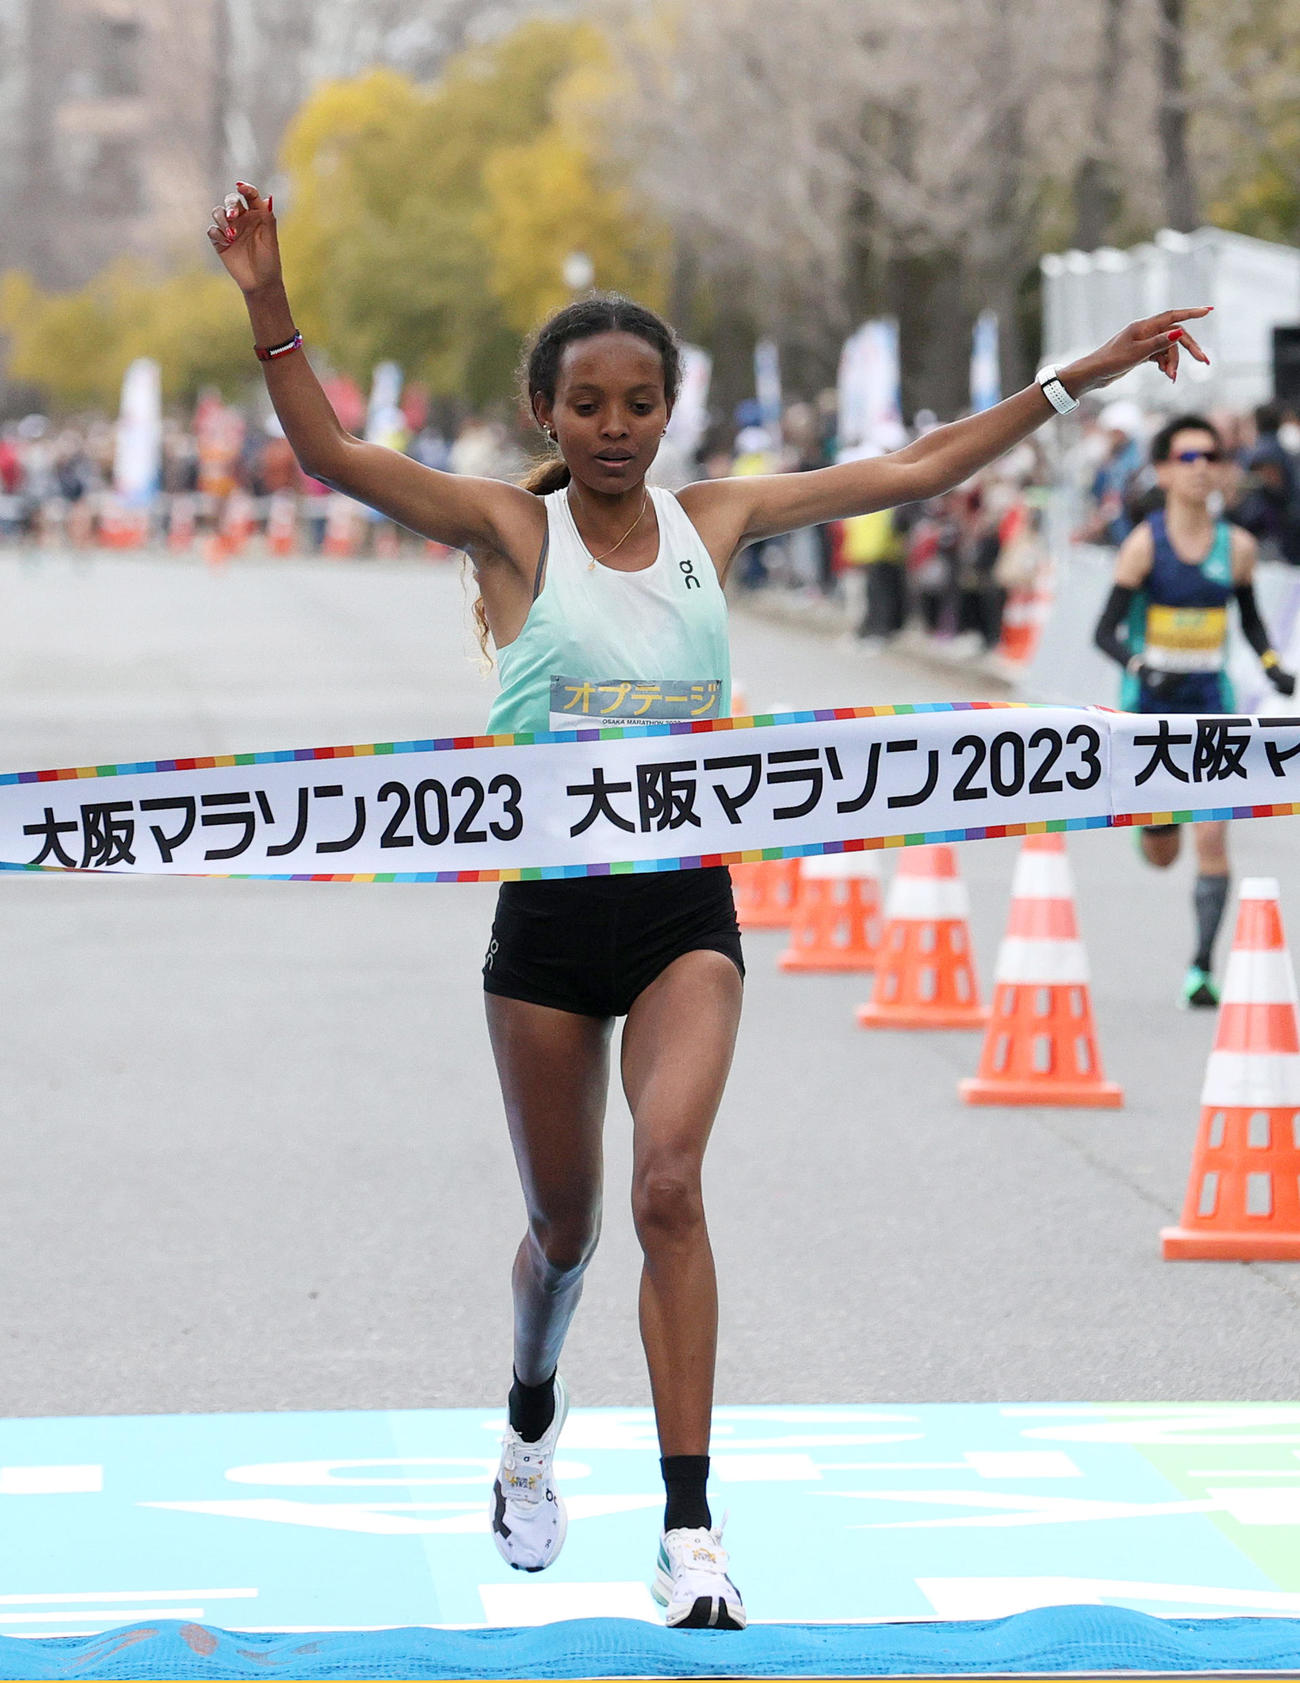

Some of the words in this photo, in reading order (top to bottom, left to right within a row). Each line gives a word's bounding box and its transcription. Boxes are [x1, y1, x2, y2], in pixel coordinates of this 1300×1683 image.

[563, 682, 717, 716] オプテージ
[1133, 717, 1300, 787] 大阪マ
